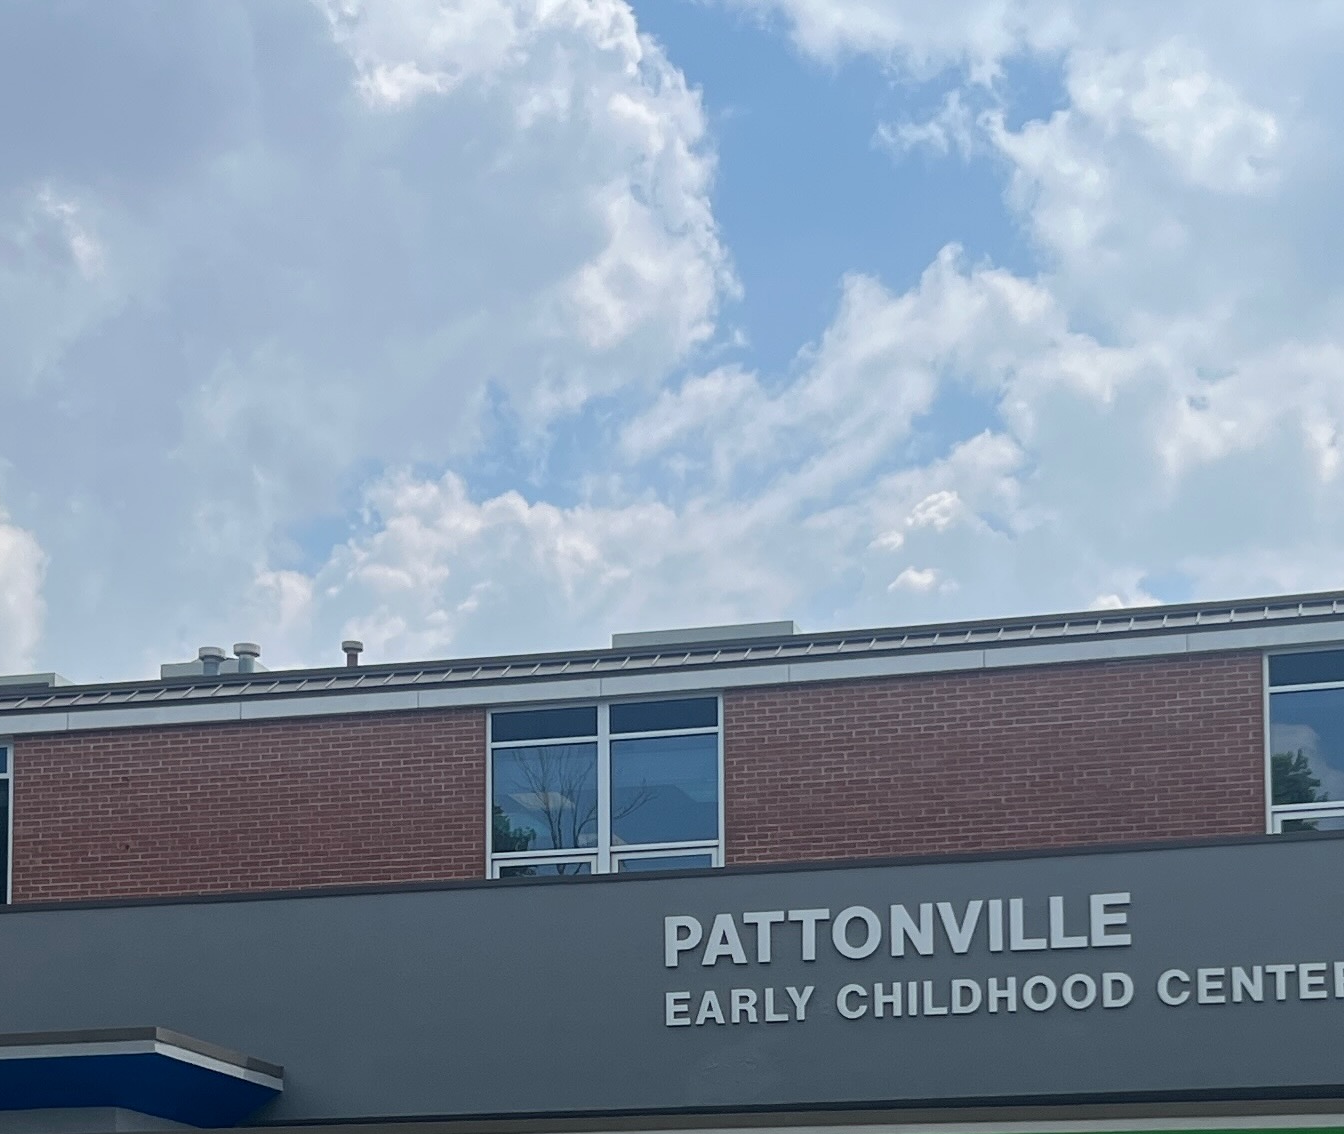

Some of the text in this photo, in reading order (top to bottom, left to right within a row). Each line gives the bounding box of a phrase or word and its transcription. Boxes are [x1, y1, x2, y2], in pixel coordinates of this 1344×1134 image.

[664, 892, 1133, 968] PATTONVILLE
[665, 985, 815, 1027] EARLY
[836, 971, 1135, 1020] CHILDHOOD
